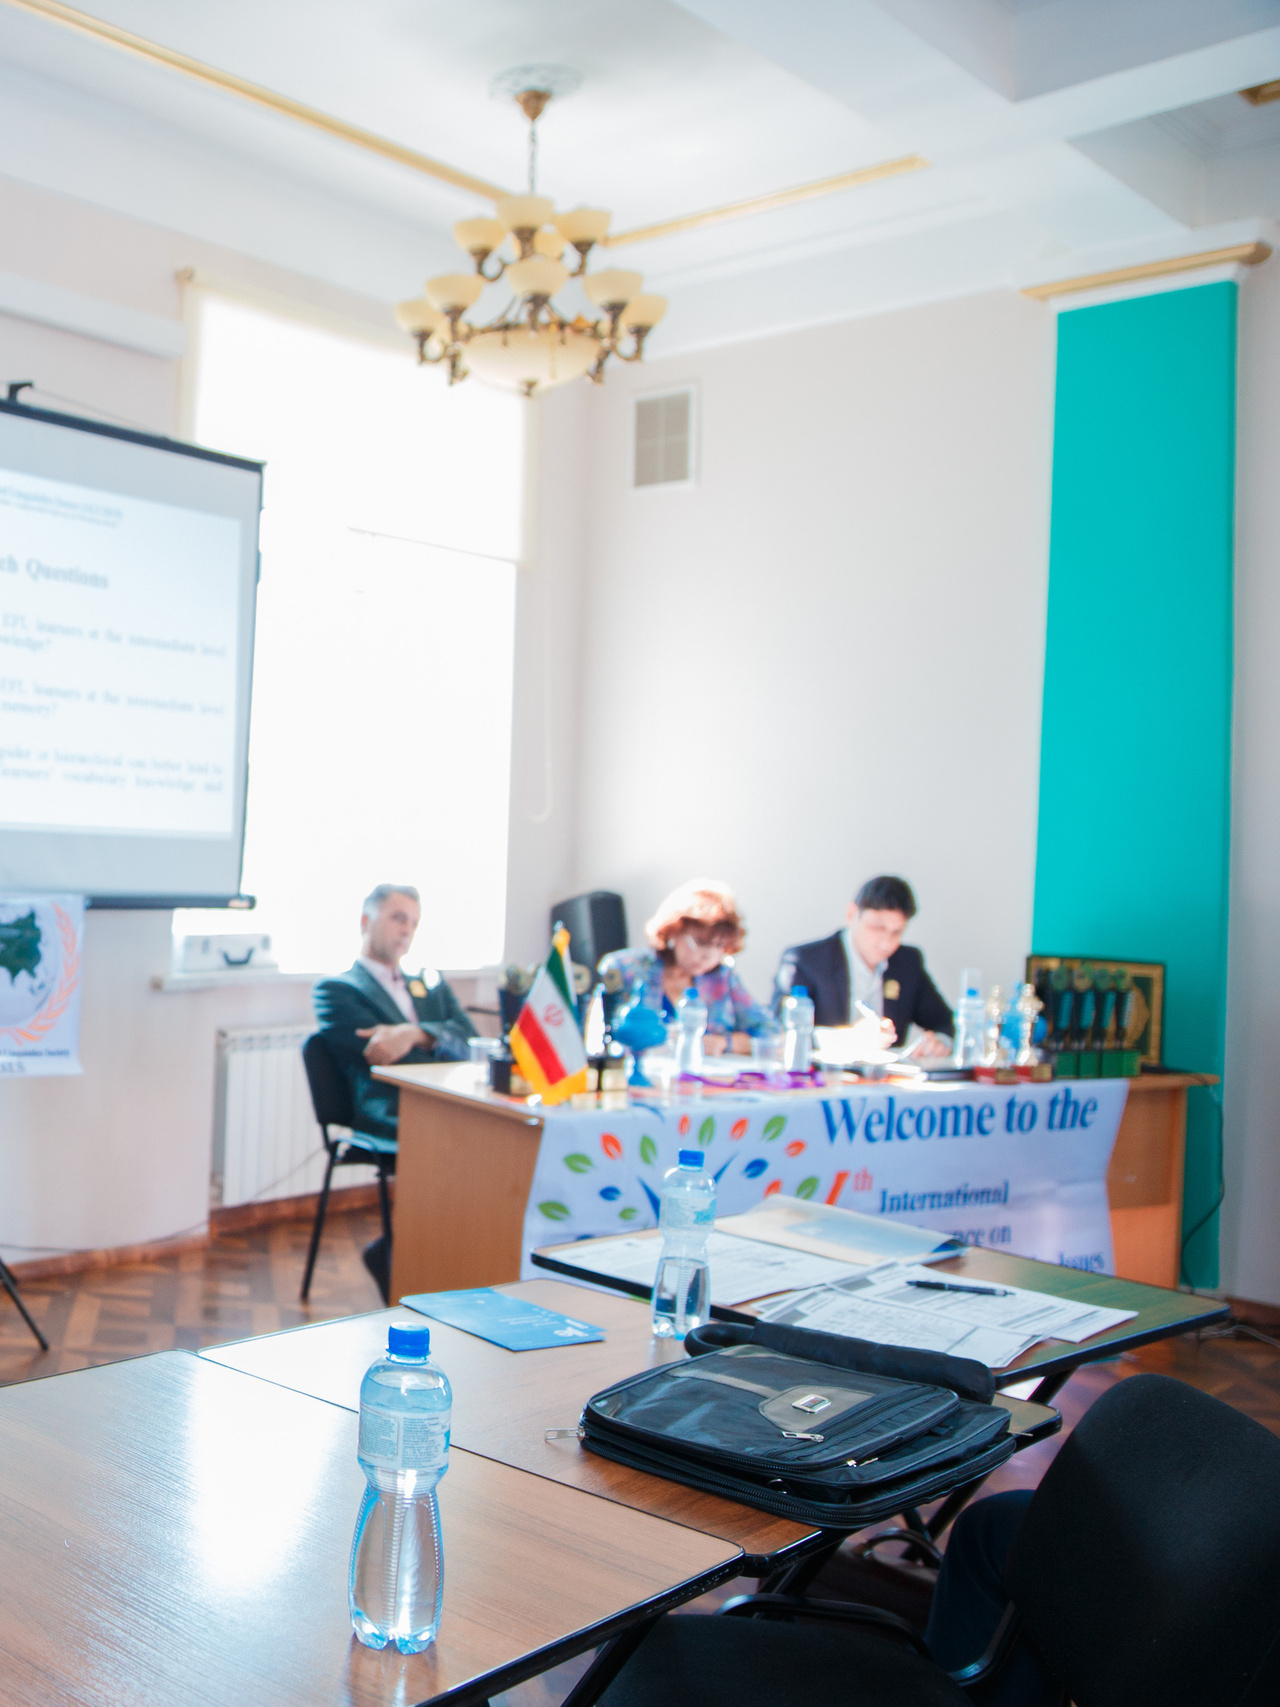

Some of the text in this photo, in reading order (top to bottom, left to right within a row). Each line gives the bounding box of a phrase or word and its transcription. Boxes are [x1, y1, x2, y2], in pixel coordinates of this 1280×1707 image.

[26, 557, 109, 589] Questions
[820, 1087, 1098, 1145] Welcome to the
[880, 1180, 1010, 1214] International
[990, 1225, 1012, 1244] on
